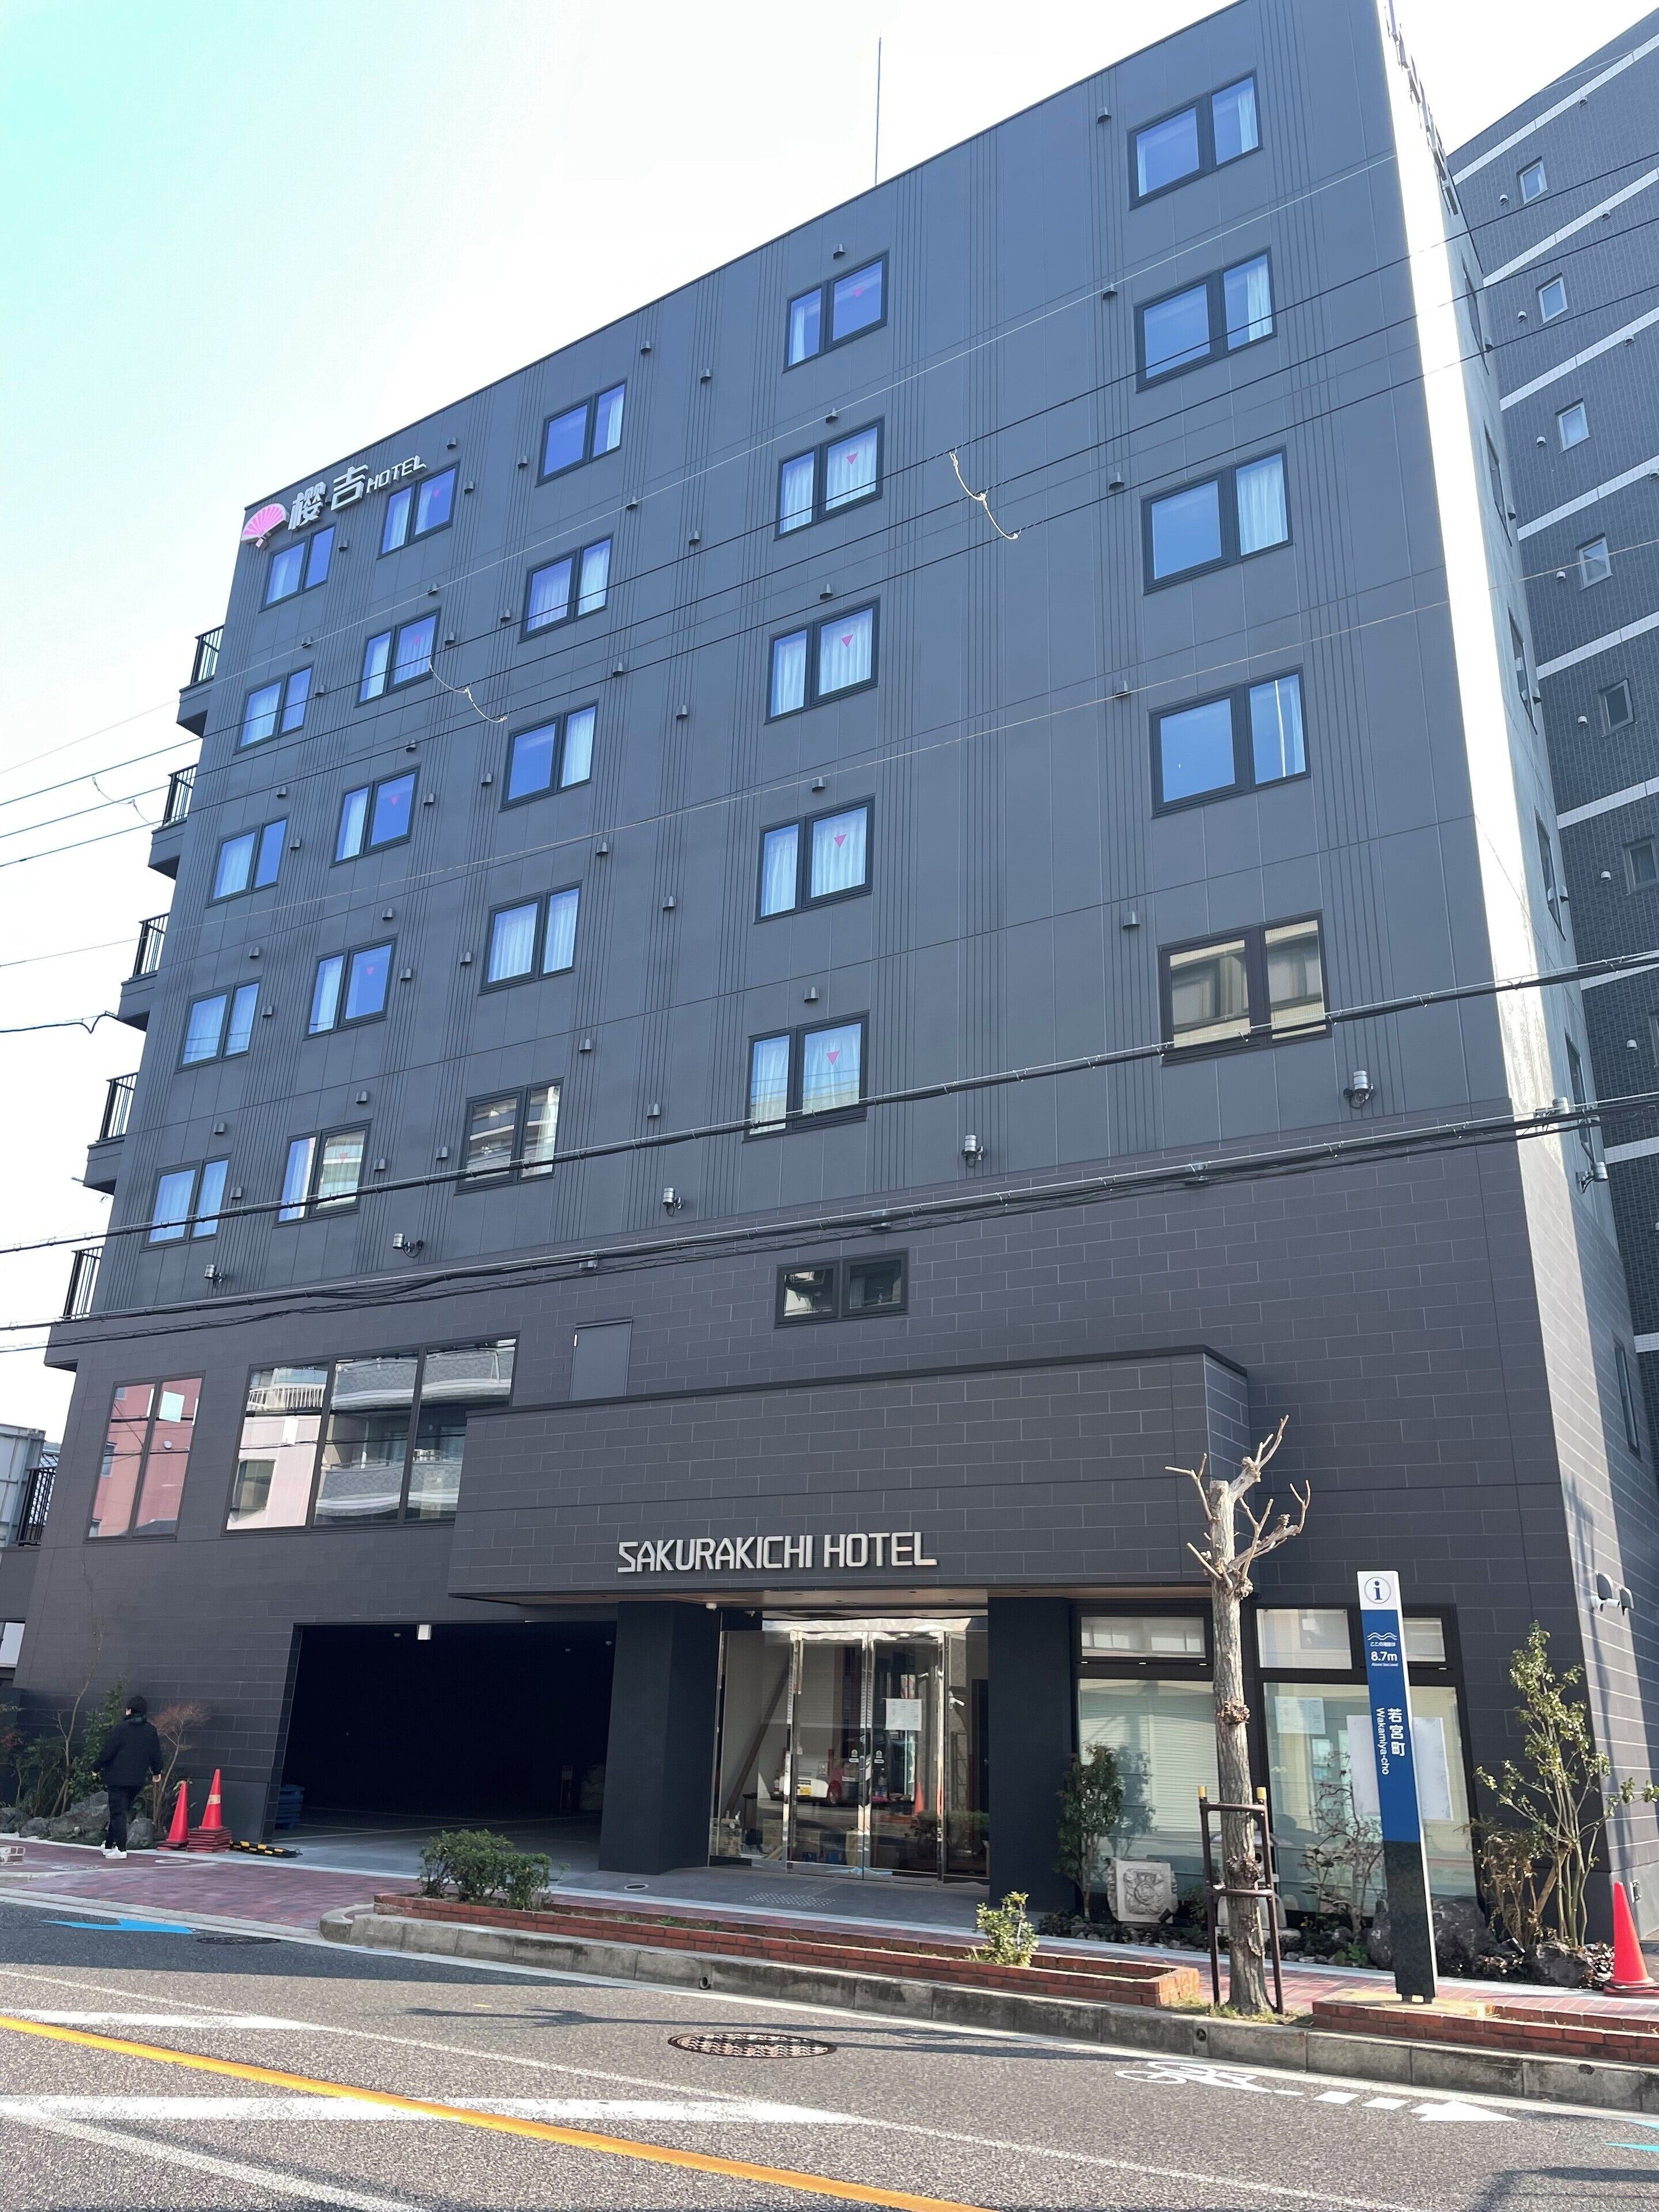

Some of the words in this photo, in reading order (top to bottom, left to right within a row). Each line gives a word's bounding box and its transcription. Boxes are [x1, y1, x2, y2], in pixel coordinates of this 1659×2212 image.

[366, 455, 427, 494] HOTEL
[618, 1535, 813, 1573] SAKURAKICHI
[823, 1531, 938, 1568] HOTEL
[1371, 1651, 1398, 1661] 8.7m
[1376, 1707, 1390, 1775] Wakamiya-cho
[1387, 1707, 1406, 1756] 若宮町
